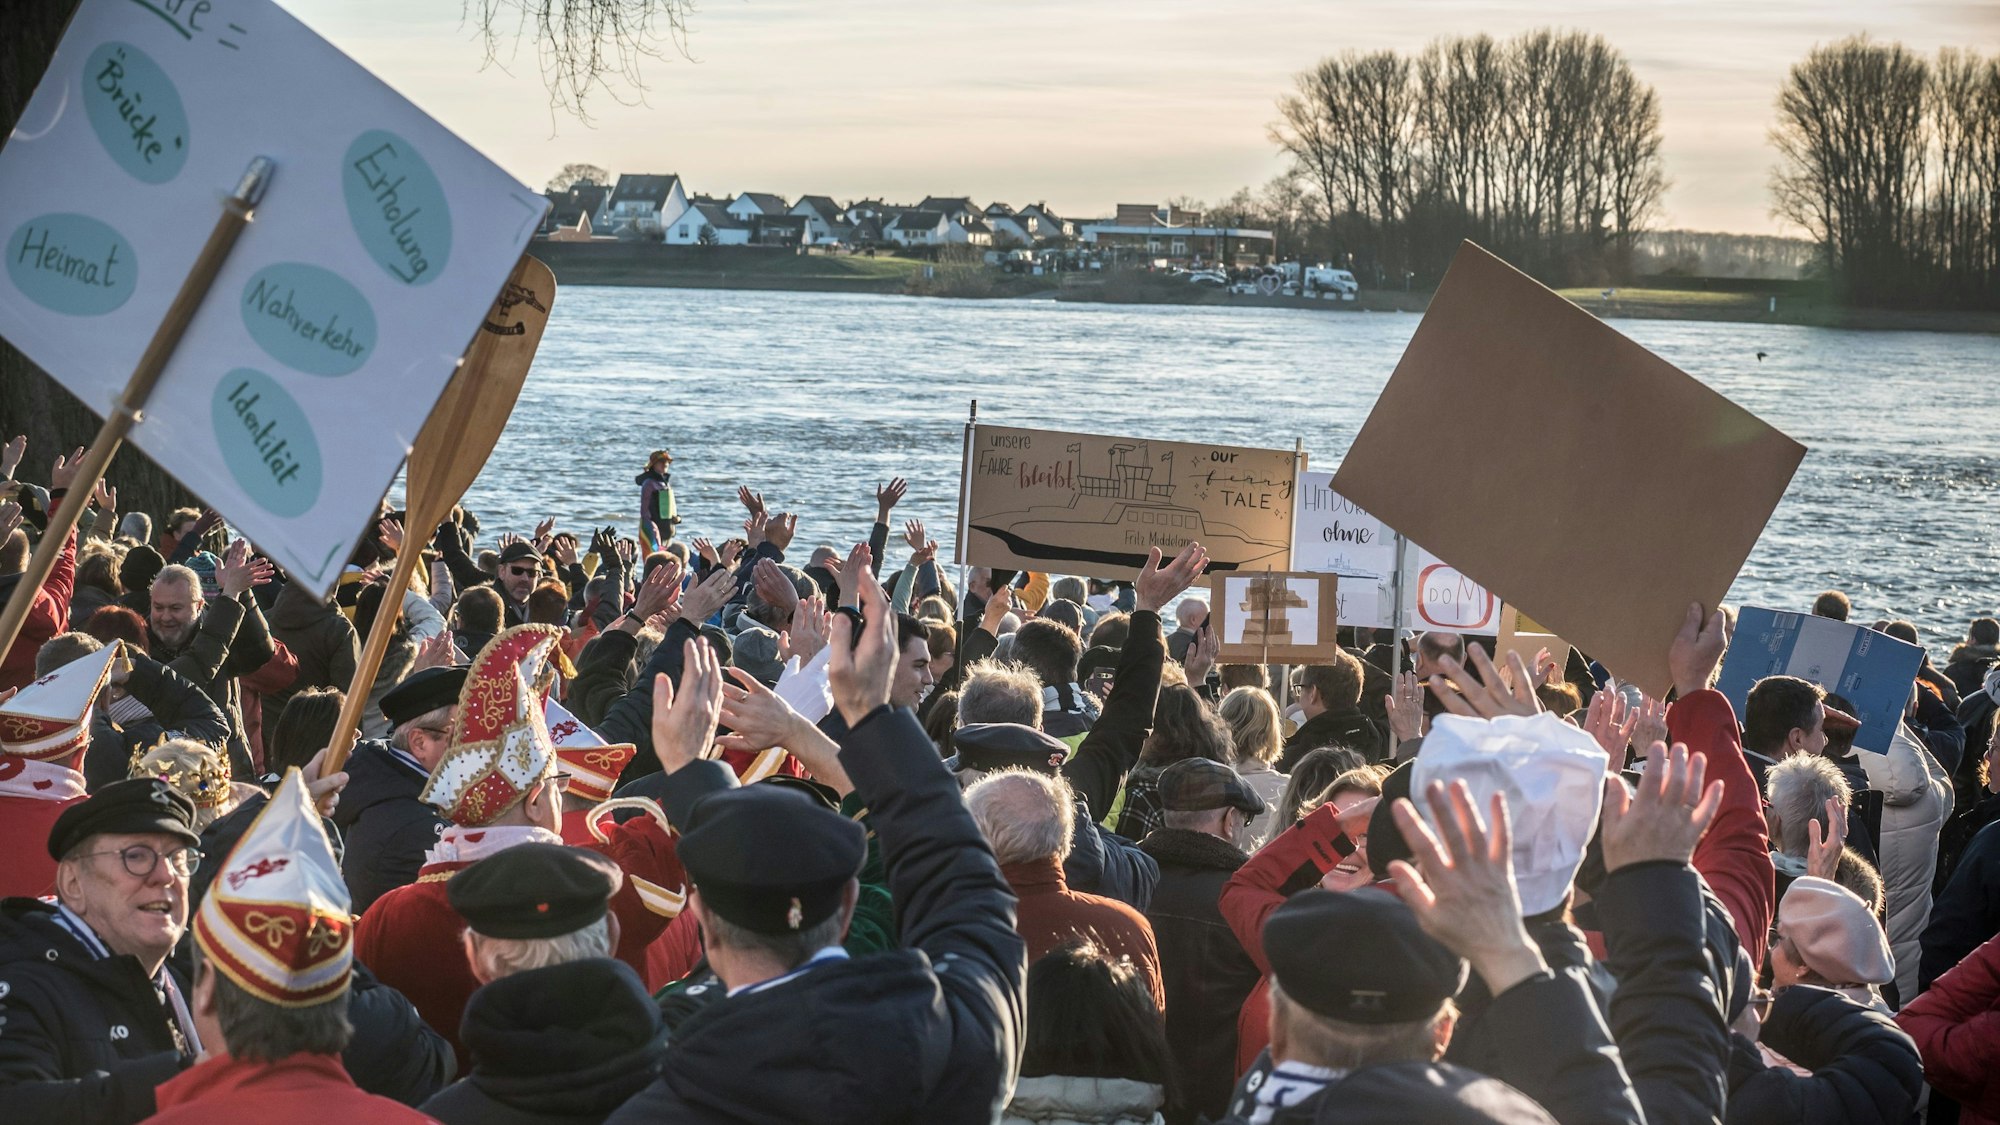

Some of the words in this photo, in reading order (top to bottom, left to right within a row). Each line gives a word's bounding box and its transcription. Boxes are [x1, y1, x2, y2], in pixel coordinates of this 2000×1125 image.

[354, 142, 428, 284] Erholung
[18, 226, 119, 288] Heimat
[247, 278, 365, 358] Nahverkehr
[990, 434, 1031, 450] unsere
[1189, 469, 1292, 500] ferry
[1220, 490, 1272, 510] TALE
[1323, 519, 1375, 545] ohne
